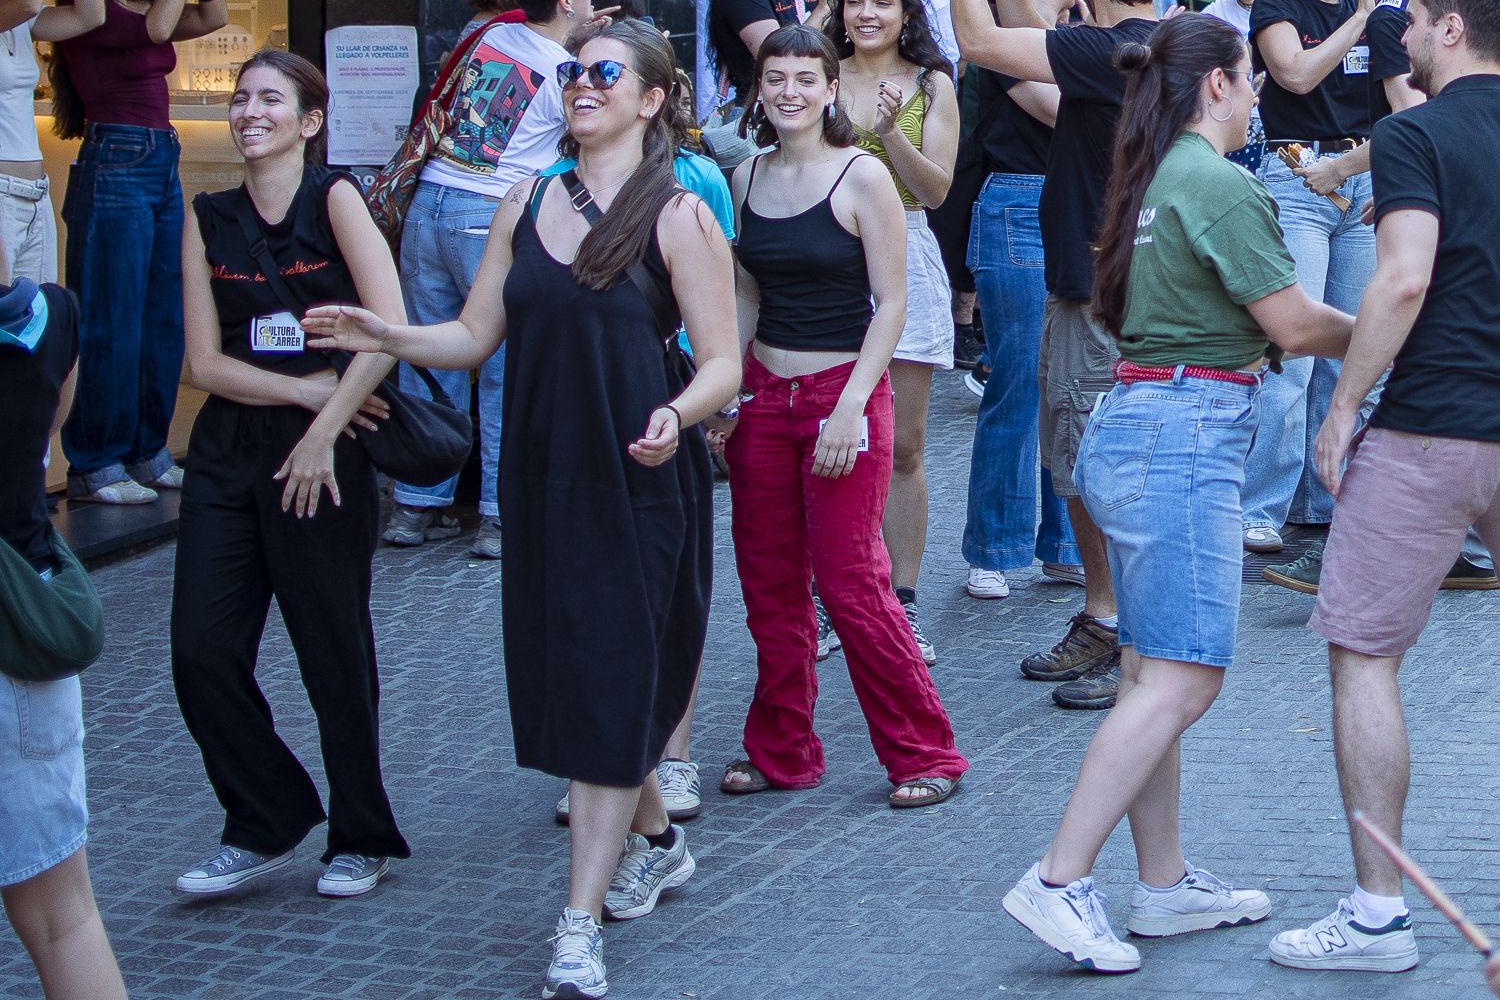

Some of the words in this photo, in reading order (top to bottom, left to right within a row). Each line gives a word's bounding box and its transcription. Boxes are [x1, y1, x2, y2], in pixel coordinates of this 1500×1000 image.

[259, 326, 296, 336] CULTURA
[269, 336, 301, 347] CARRER
[1315, 924, 1348, 954] N
